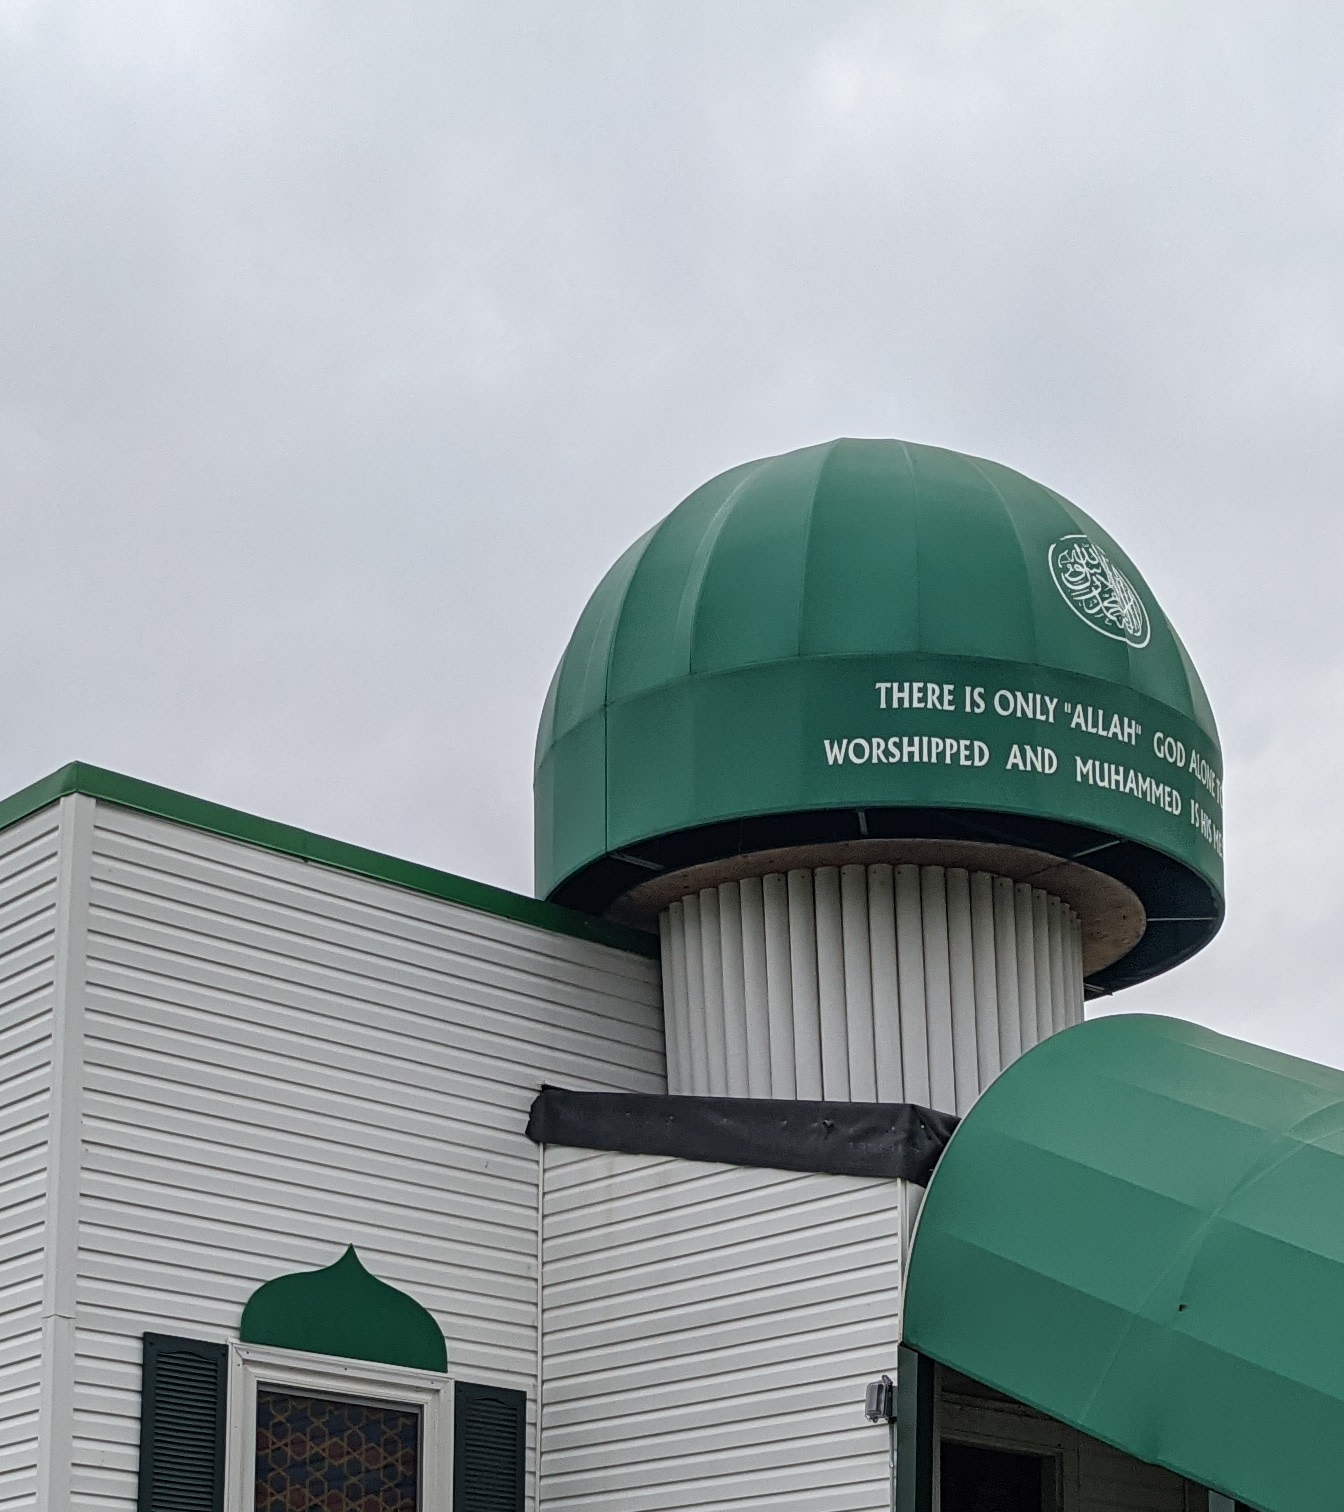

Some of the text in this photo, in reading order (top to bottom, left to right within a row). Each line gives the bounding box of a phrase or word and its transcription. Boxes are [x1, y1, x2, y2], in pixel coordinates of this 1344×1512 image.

[824, 737, 989, 766] WORSHIPPED
[1006, 745, 1057, 773] AND
[1075, 756, 1181, 815] MUHAMMED
[1190, 798, 1200, 828] IS
[876, 682, 955, 710] THERE
[965, 687, 985, 713] IS
[994, 690, 1058, 722] ONLY
[1065, 703, 1141, 745] "ALLAH"
[1154, 732, 1185, 767] GOD
[1189, 750, 1215, 797] ALONE
